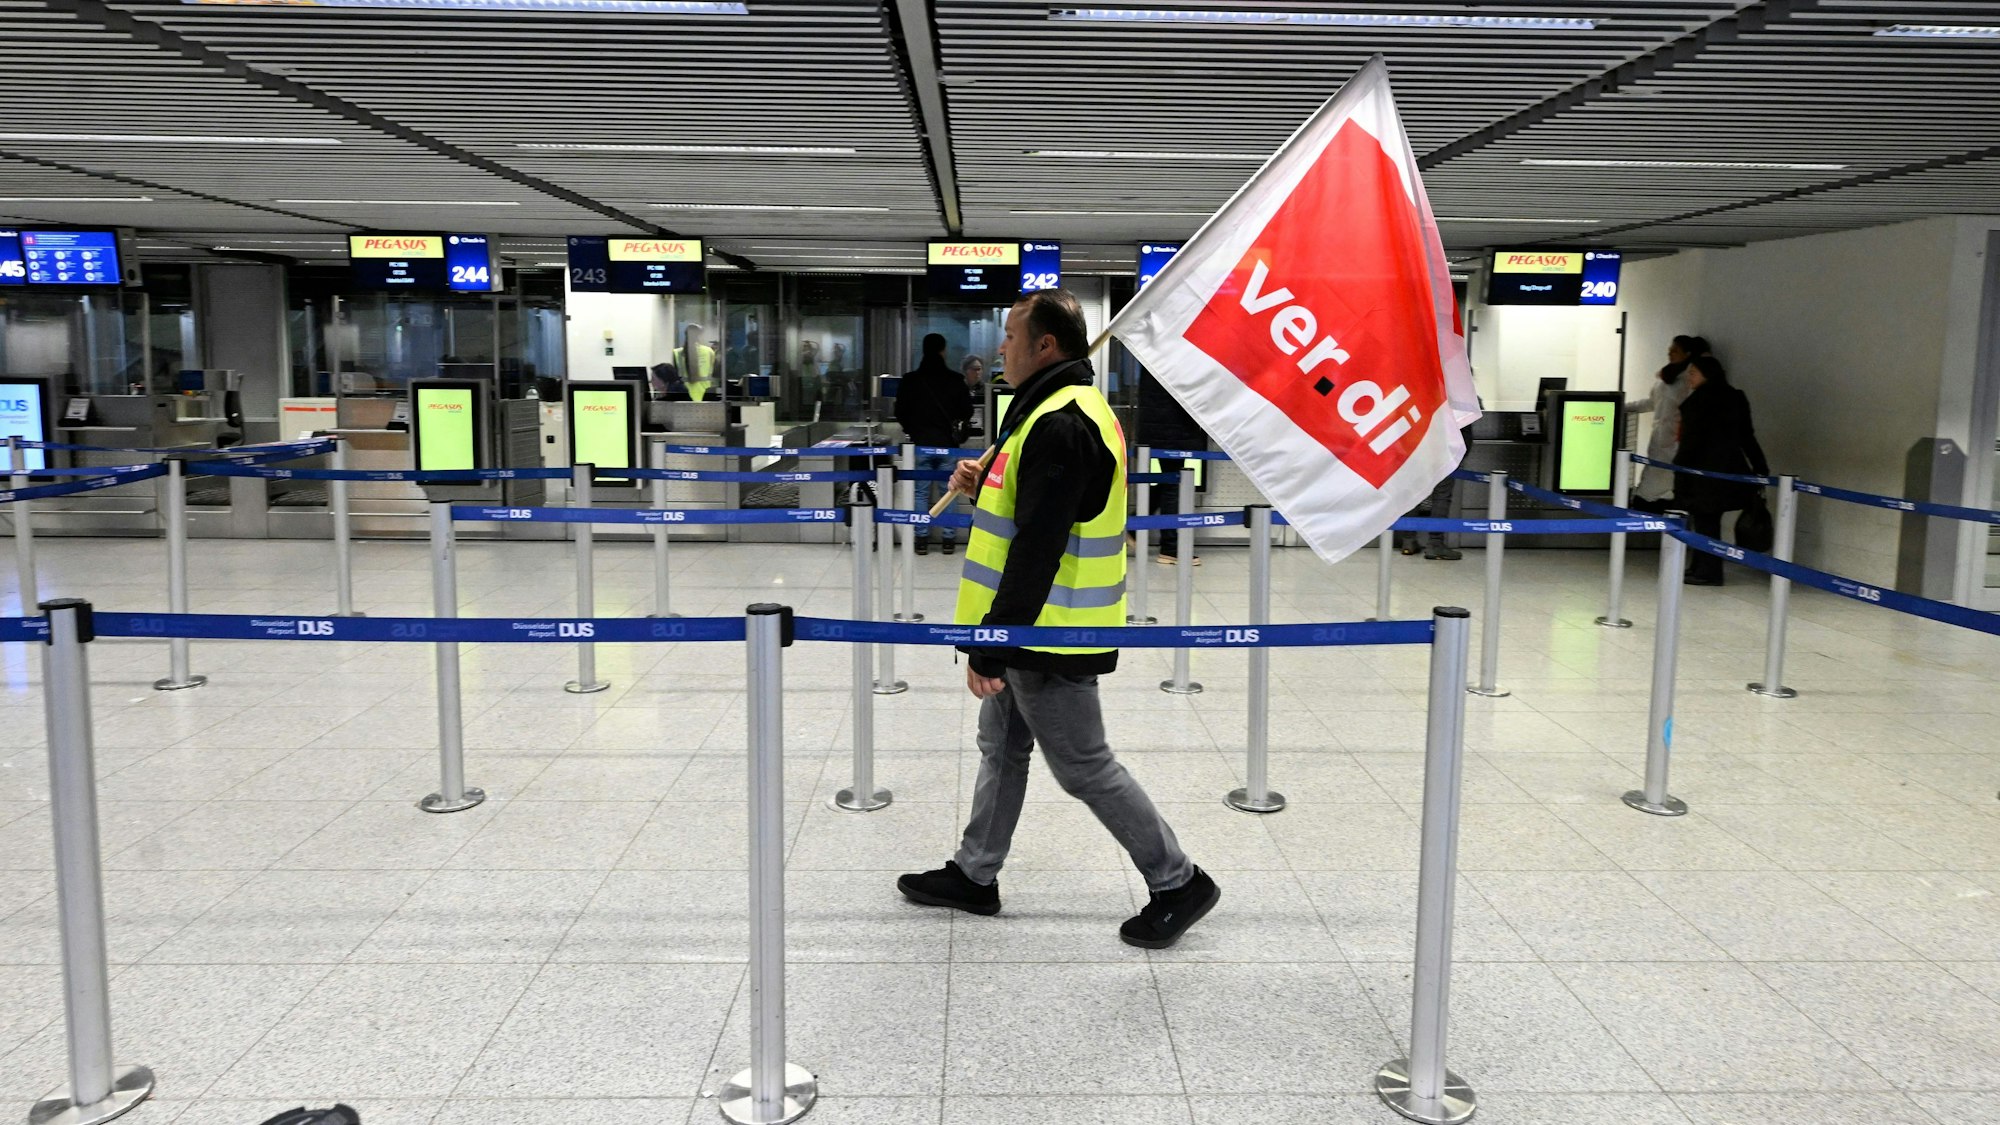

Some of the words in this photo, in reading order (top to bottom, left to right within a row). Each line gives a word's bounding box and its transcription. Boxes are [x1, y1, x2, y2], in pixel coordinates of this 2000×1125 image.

[364, 239, 427, 250] PEGASUS
[624, 242, 686, 254] PEGASUS
[942, 246, 1004, 258] PEGASUS
[1507, 256, 1568, 266] PEGASUS
[0, 260, 26, 278] 45
[452, 266, 489, 283] 244
[572, 268, 606, 284] 243
[1022, 272, 1058, 290] 242
[1580, 281, 1616, 298] 240
[1240, 258, 1422, 456] ver.di
[510, 508, 532, 518] DUS
[662, 512, 684, 520] DUS
[814, 510, 836, 520] DUS
[910, 514, 931, 524] DUS
[1204, 515, 1225, 524] DUS
[1490, 522, 1512, 532] DUS
[1644, 521, 1667, 530] DUS
[1858, 586, 1880, 601] DUS
[298, 620, 334, 636] DUS
[558, 622, 595, 638] DUS
[974, 628, 1009, 642] DUS
[1226, 629, 1260, 643] DUS
